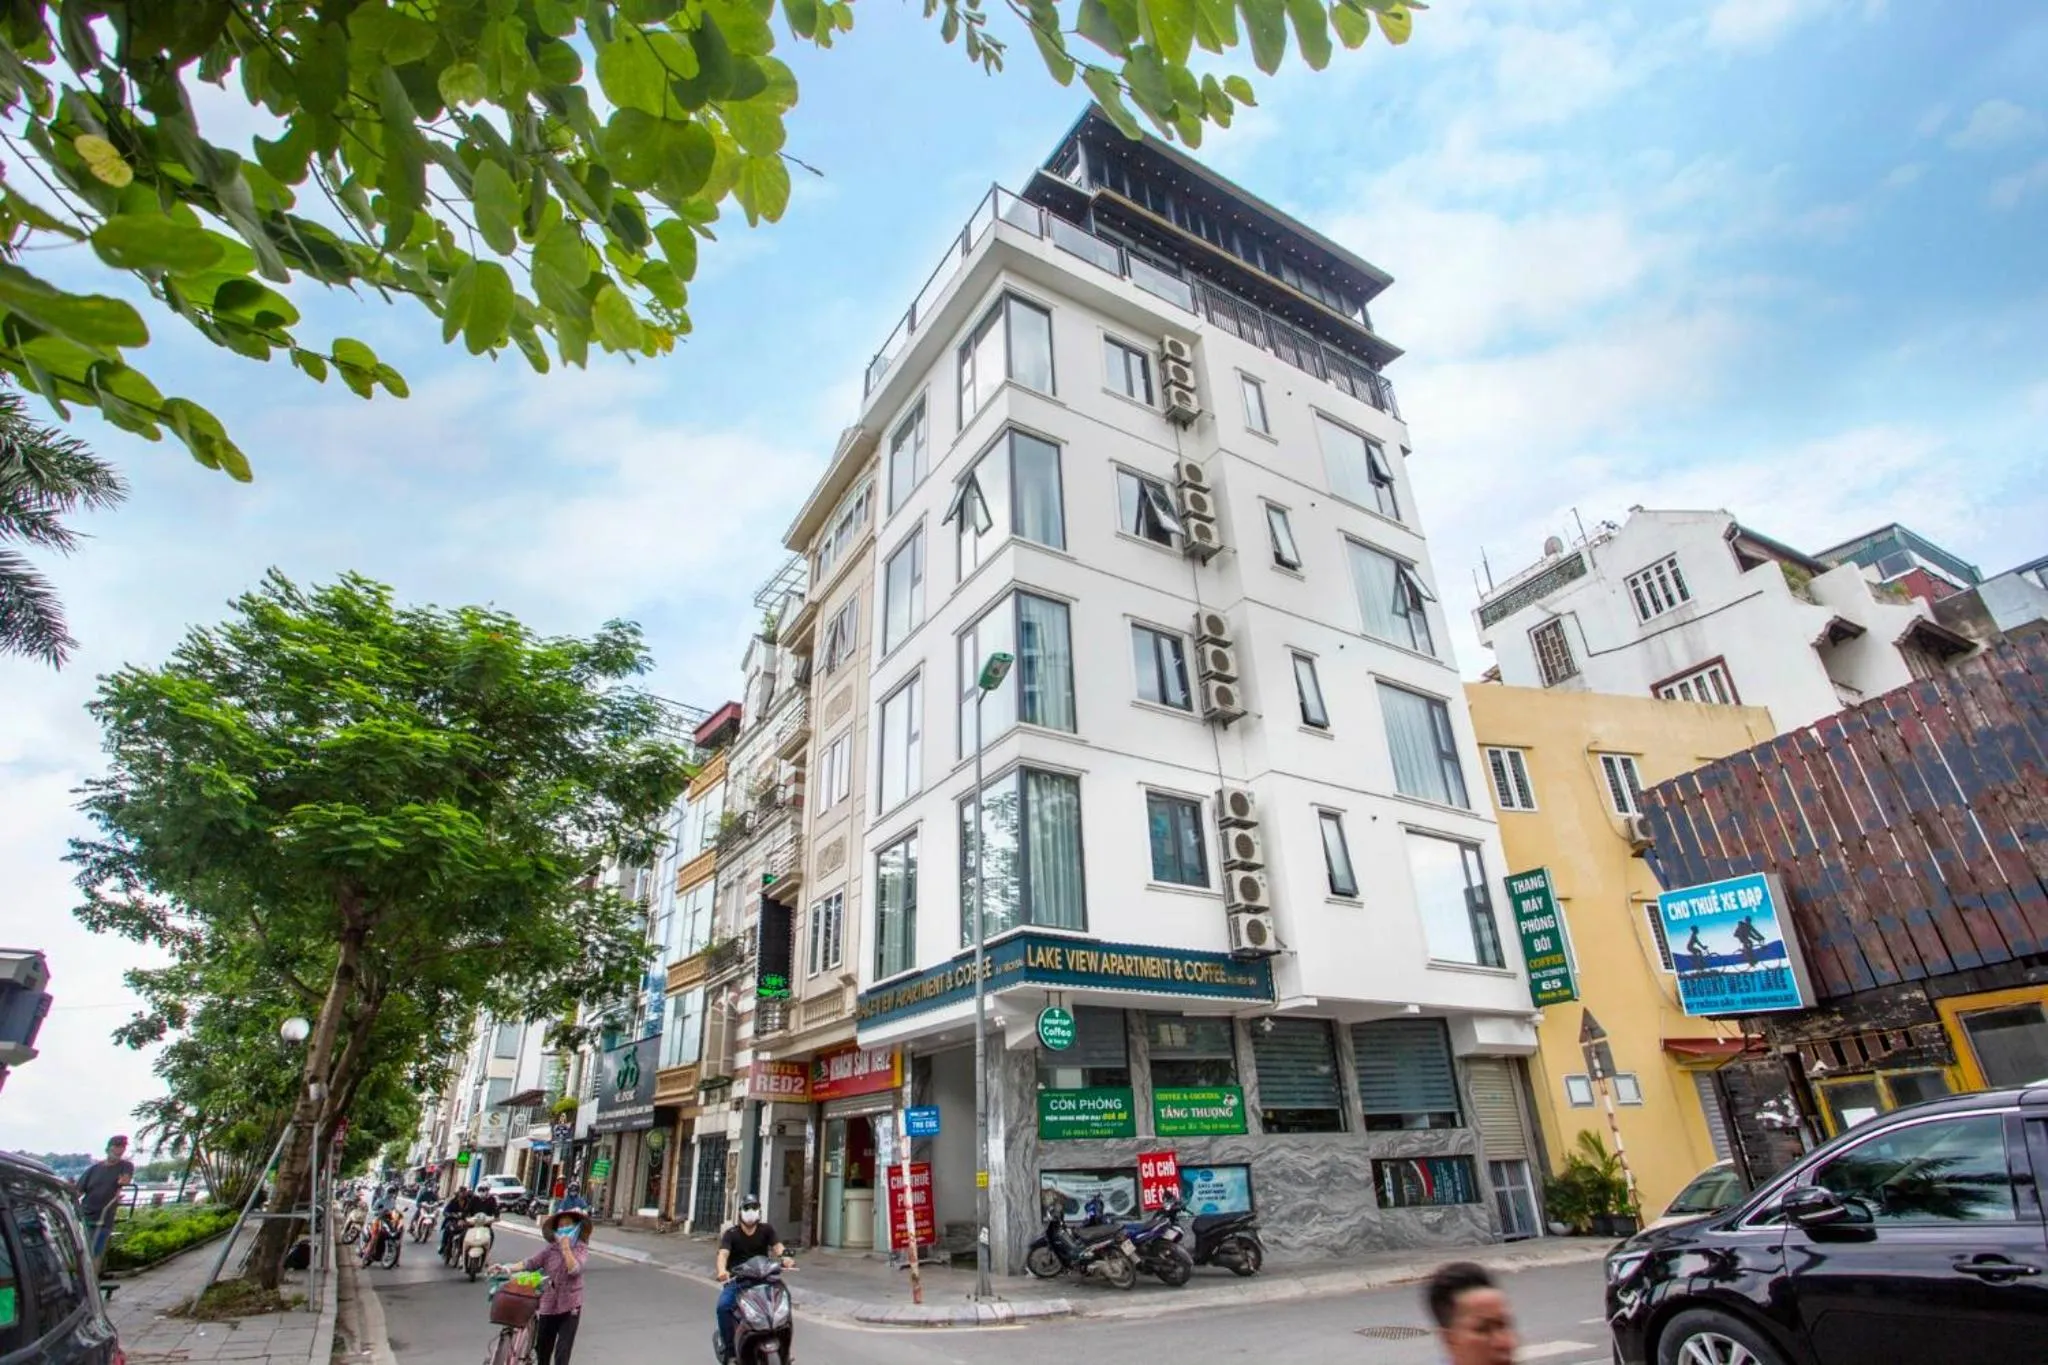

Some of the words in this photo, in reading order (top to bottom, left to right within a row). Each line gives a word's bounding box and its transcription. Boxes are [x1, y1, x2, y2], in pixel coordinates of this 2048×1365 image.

[1512, 875, 1545, 895] THANG
[1521, 895, 1543, 914] MÁY
[1667, 899, 1691, 921] CHO
[1720, 891, 1739, 912] XE
[1521, 914, 1555, 935] PHÒNG
[1027, 944, 1062, 970] LAKE
[1065, 949, 1100, 972] VIEW
[1100, 952, 1173, 979] APARTMENT
[1173, 959, 1184, 980] &
[1184, 961, 1226, 984] COFFEE
[1529, 955, 1565, 970] COFFEE
[1541, 979, 1562, 991] 65
[1727, 970, 1760, 996] WEST
[760, 1062, 801, 1075] HOTEL
[756, 1074, 806, 1094] RED2
[1142, 1159, 1155, 1178] CÓ
